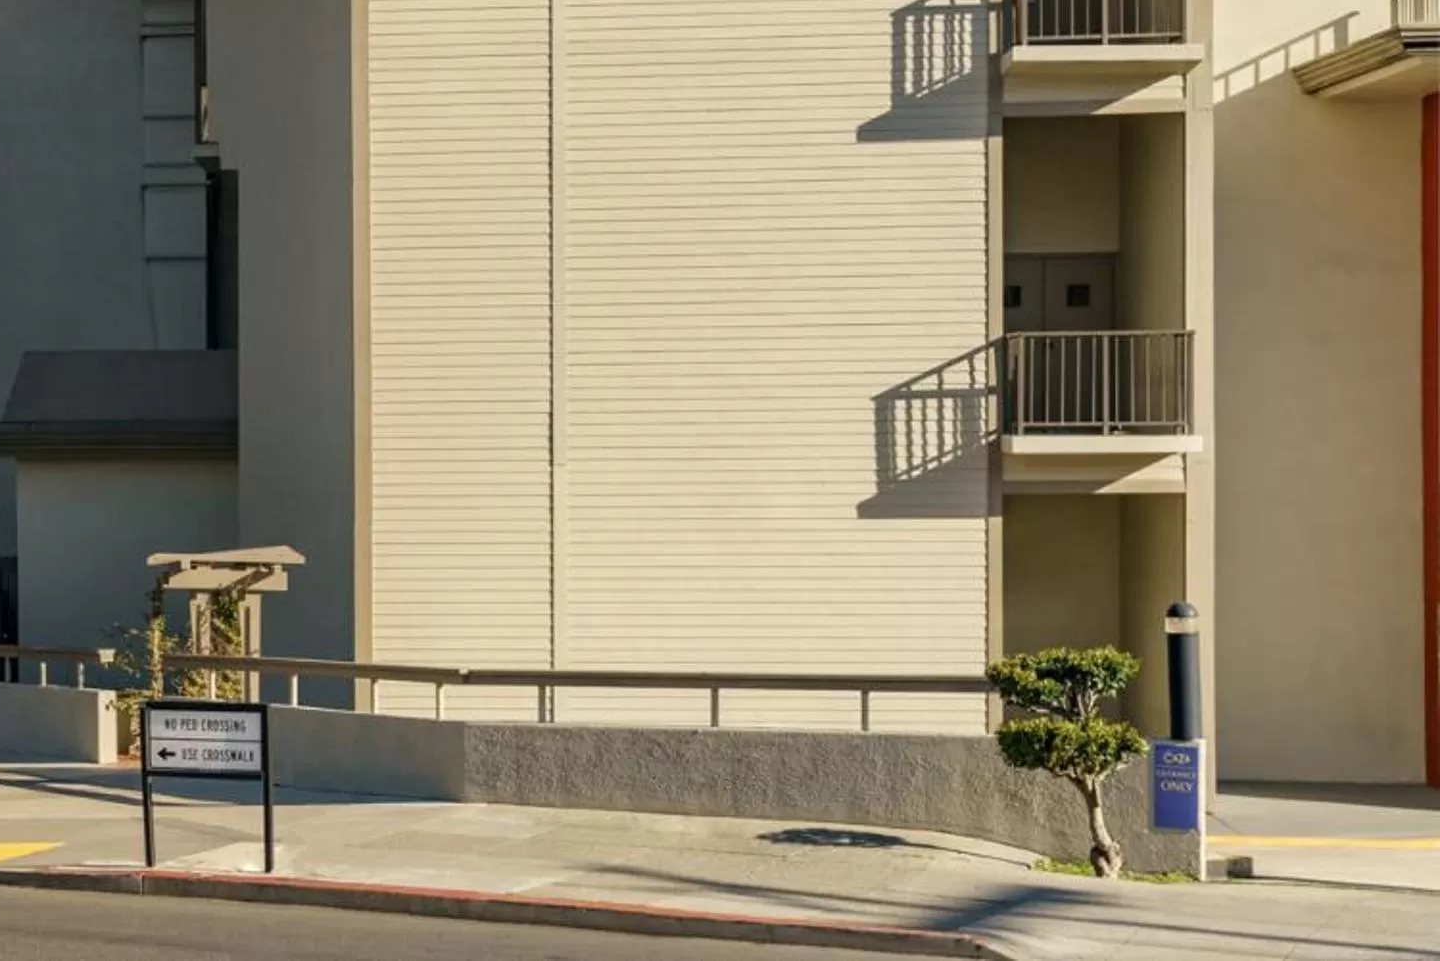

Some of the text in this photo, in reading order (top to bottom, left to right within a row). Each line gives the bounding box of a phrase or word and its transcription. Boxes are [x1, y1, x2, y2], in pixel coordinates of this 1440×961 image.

[164, 718, 247, 733] NO PED CROSSING
[182, 748, 254, 762] USE CROSSWALK
